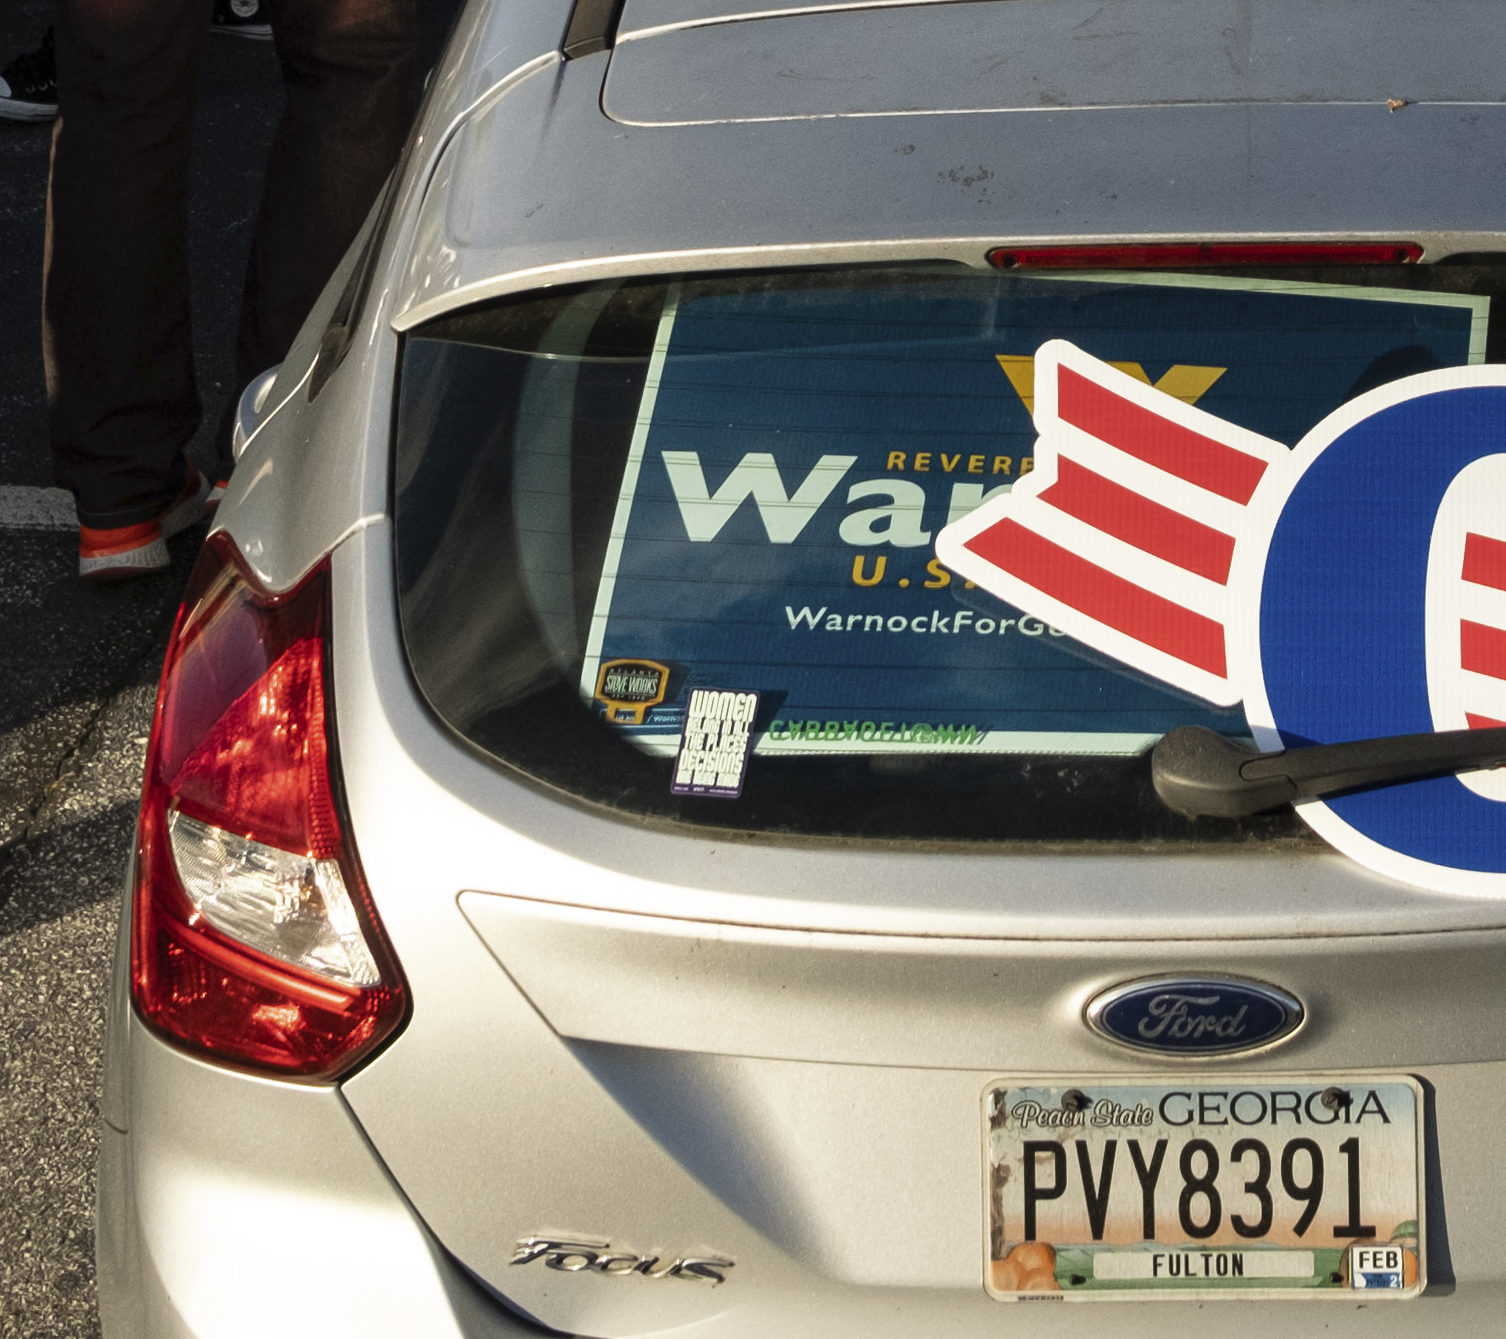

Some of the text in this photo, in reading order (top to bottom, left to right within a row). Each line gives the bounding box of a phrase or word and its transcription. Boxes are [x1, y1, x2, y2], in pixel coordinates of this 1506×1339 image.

[886, 451, 1035, 475] REVERE
[688, 689, 757, 723] WOMEN
[684, 732, 748, 754] THE PLACES
[679, 748, 744, 775] DECISIONS
[1136, 994, 1247, 1042] Ford
[1011, 1089, 1391, 1129] Peach State GEORGIA
[1023, 1137, 1376, 1241] PVY8391
[1152, 1253, 1244, 1278] FULTON
[1358, 1250, 1399, 1270] FEB
